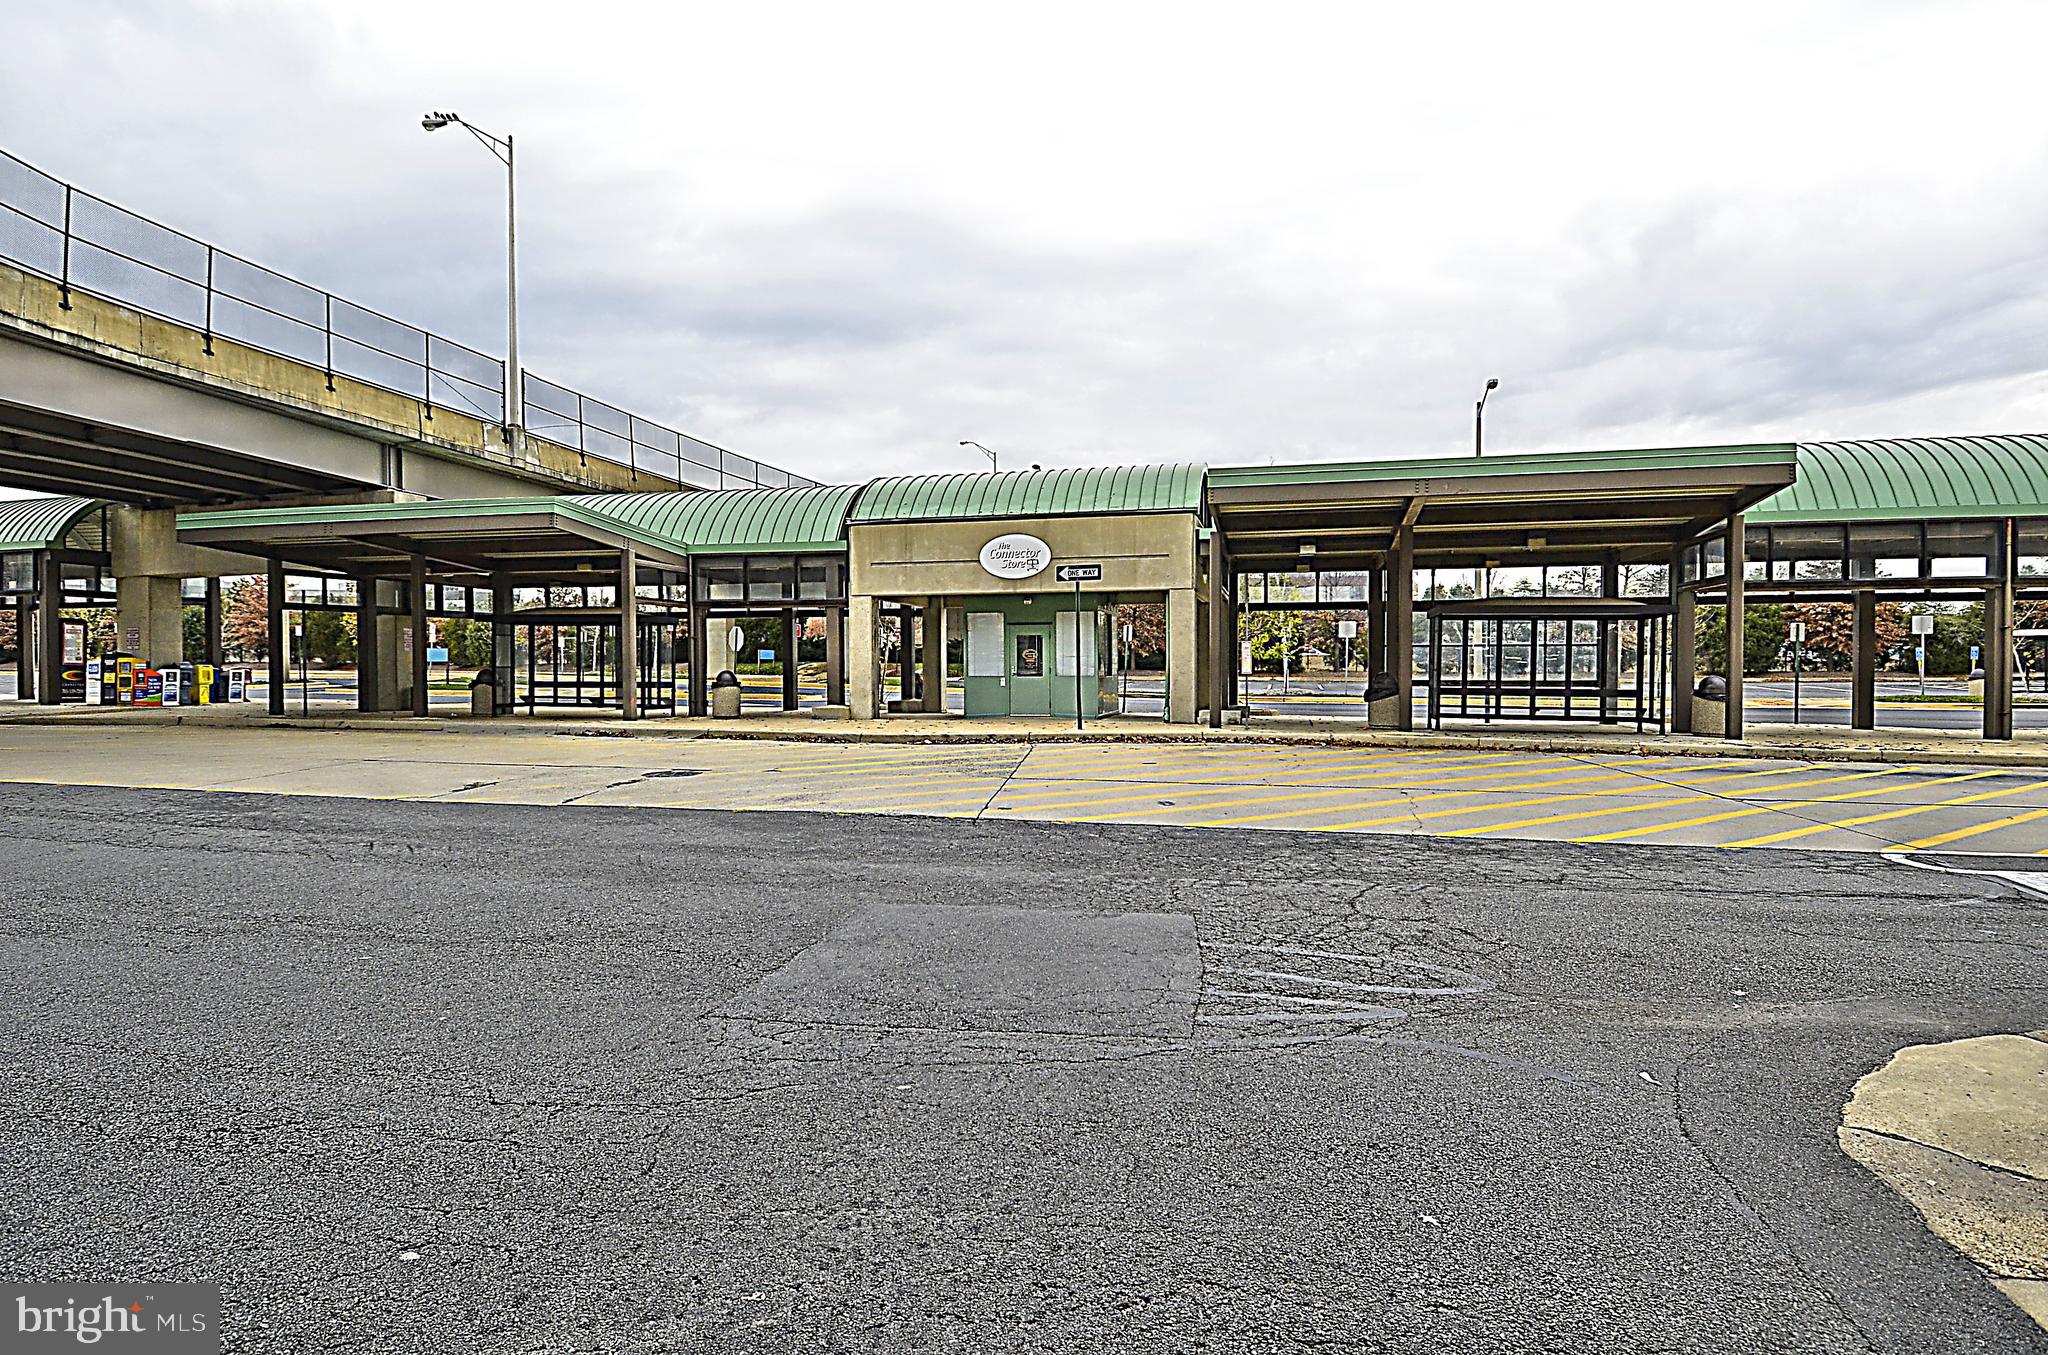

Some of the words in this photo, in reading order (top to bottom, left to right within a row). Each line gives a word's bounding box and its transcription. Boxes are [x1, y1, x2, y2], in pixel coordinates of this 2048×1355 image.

[998, 542, 1011, 550] The
[990, 548, 1041, 560] Connector
[1001, 559, 1027, 569] Store
[1067, 569, 1080, 577] ONE
[1082, 568, 1096, 576] WAY
